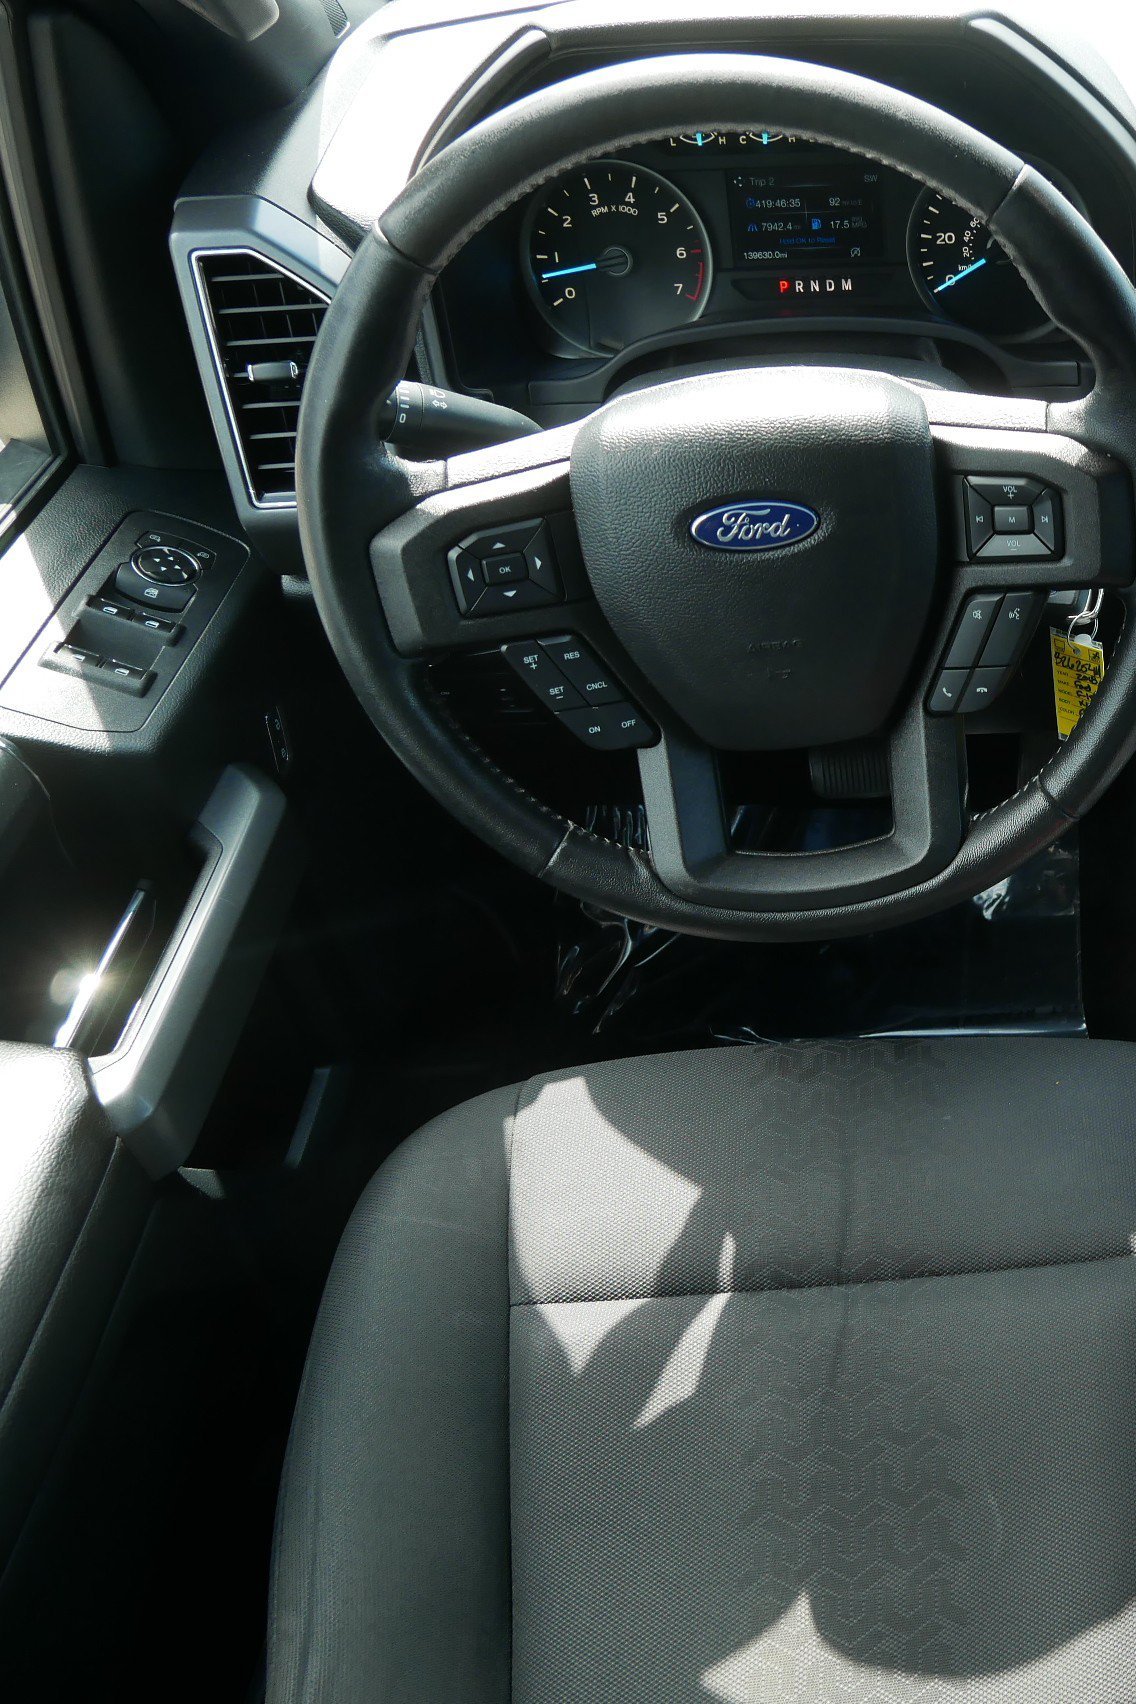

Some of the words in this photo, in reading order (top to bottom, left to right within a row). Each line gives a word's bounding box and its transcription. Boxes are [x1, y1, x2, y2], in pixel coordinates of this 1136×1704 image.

[719, 136, 727, 145] H
[739, 136, 747, 145] C
[769, 177, 774, 186] 2
[589, 193, 599, 205] 3
[624, 192, 635, 204] 4
[755, 198, 801, 208] 419:46:35
[828, 197, 840, 206] 92
[591, 206, 609, 218] RPM
[610, 204, 617, 212] X
[618, 205, 638, 216] 1000
[562, 216, 572, 227] 2
[657, 212, 668, 224] 5
[761, 222, 793, 231] 7942.4
[830, 220, 850, 229] 17.5
[936, 232, 955, 245] 20
[963, 230, 971, 242] 40
[676, 247, 687, 259] 6
[962, 246, 970, 257] 20
[555, 251, 559, 263] 1
[674, 283, 683, 295] 7
[780, 280, 788, 293] P
[795, 280, 804, 293] R
[810, 280, 820, 292] N
[826, 279, 835, 292] D
[841, 278, 853, 291] M
[565, 287, 576, 299] 0
[1003, 485, 1018, 493] VOL
[716, 508, 791, 543] Ford
[498, 566, 512, 574] OK
[523, 654, 539, 664] SET
[563, 651, 580, 660] RES
[549, 686, 564, 696] SET
[586, 681, 608, 691] CNCL
[621, 719, 636, 729] OFF
[588, 725, 601, 734] ON
